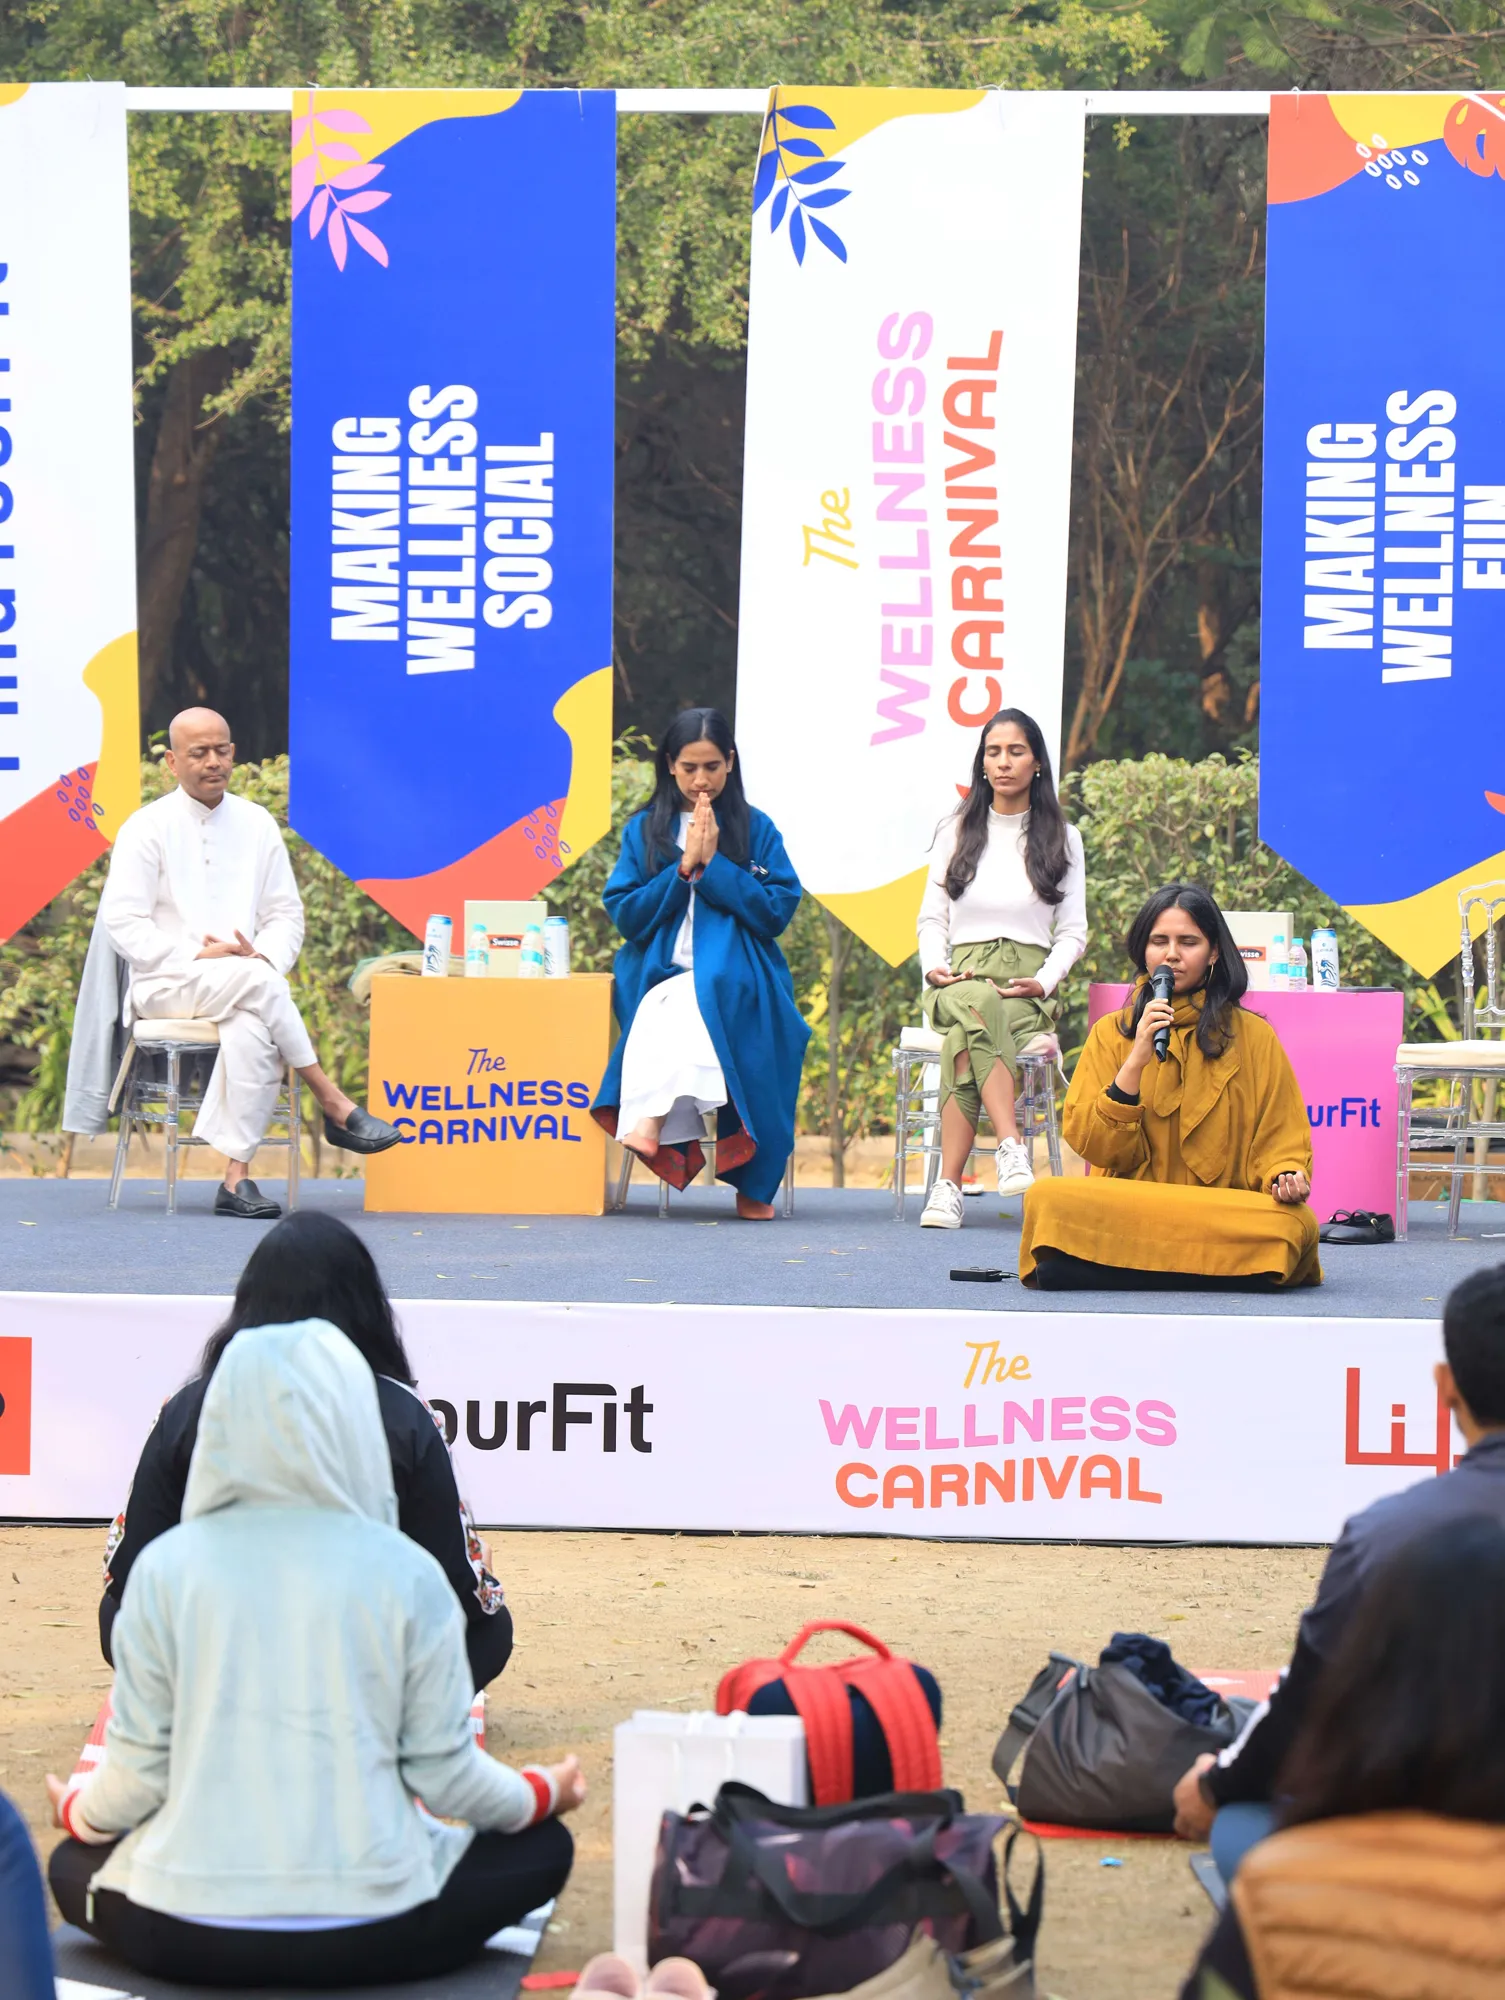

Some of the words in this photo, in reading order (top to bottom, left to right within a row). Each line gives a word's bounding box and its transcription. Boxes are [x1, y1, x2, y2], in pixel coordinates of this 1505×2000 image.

[331, 416, 401, 641] MAKING
[406, 384, 478, 676] WELLNESS
[483, 432, 554, 629] SOCIAL
[802, 486, 860, 570] The
[869, 310, 934, 747] WELLNESS
[942, 329, 1005, 728] CARNIVAL
[1303, 423, 1377, 649] MAKING
[1382, 389, 1457, 684] WELLNESS
[382, 1080, 591, 1112] WELLNESS
[466, 1048, 507, 1076] The
[392, 1114, 582, 1145] CARNIVAL
[1306, 1097, 1381, 1128] urFit
[963, 1340, 1032, 1390] The
[428, 1382, 654, 1454] ourFit
[818, 1394, 1178, 1451] WELLNESS
[835, 1454, 1163, 1510] CARNIVAL
